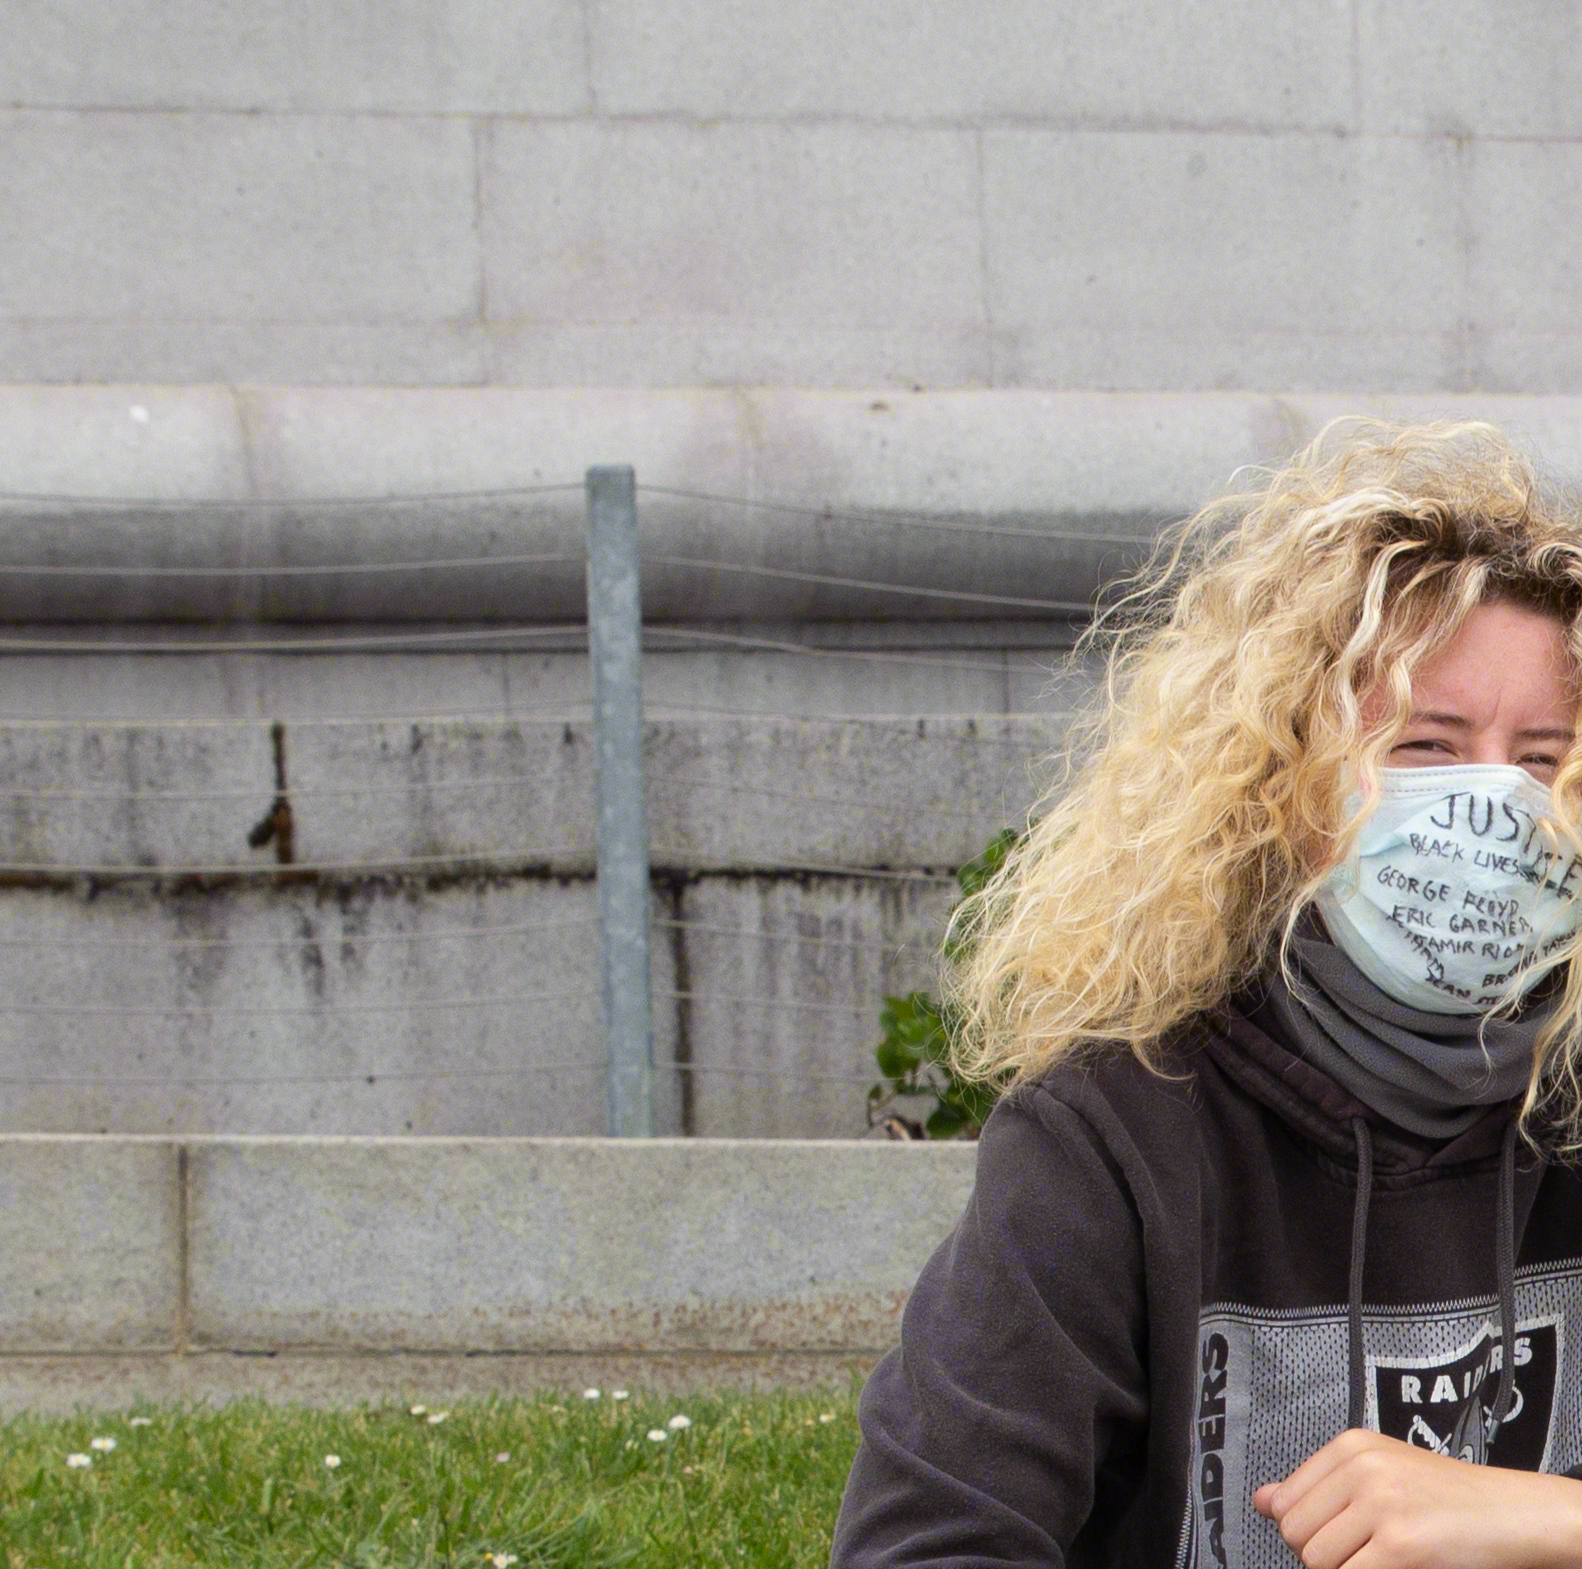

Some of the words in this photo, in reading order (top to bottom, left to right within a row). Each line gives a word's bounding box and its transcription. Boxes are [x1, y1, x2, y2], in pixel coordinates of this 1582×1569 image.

[1409, 833, 1465, 863] BLACK
[1474, 849, 1520, 875] LIVES
[1377, 865, 1451, 902] GEORGE
[1462, 889, 1520, 920] FLOYD
[1392, 904, 1436, 928] ERIC
[1449, 914, 1534, 937] GARNER
[1401, 1337, 1533, 1404] RAIDRS
